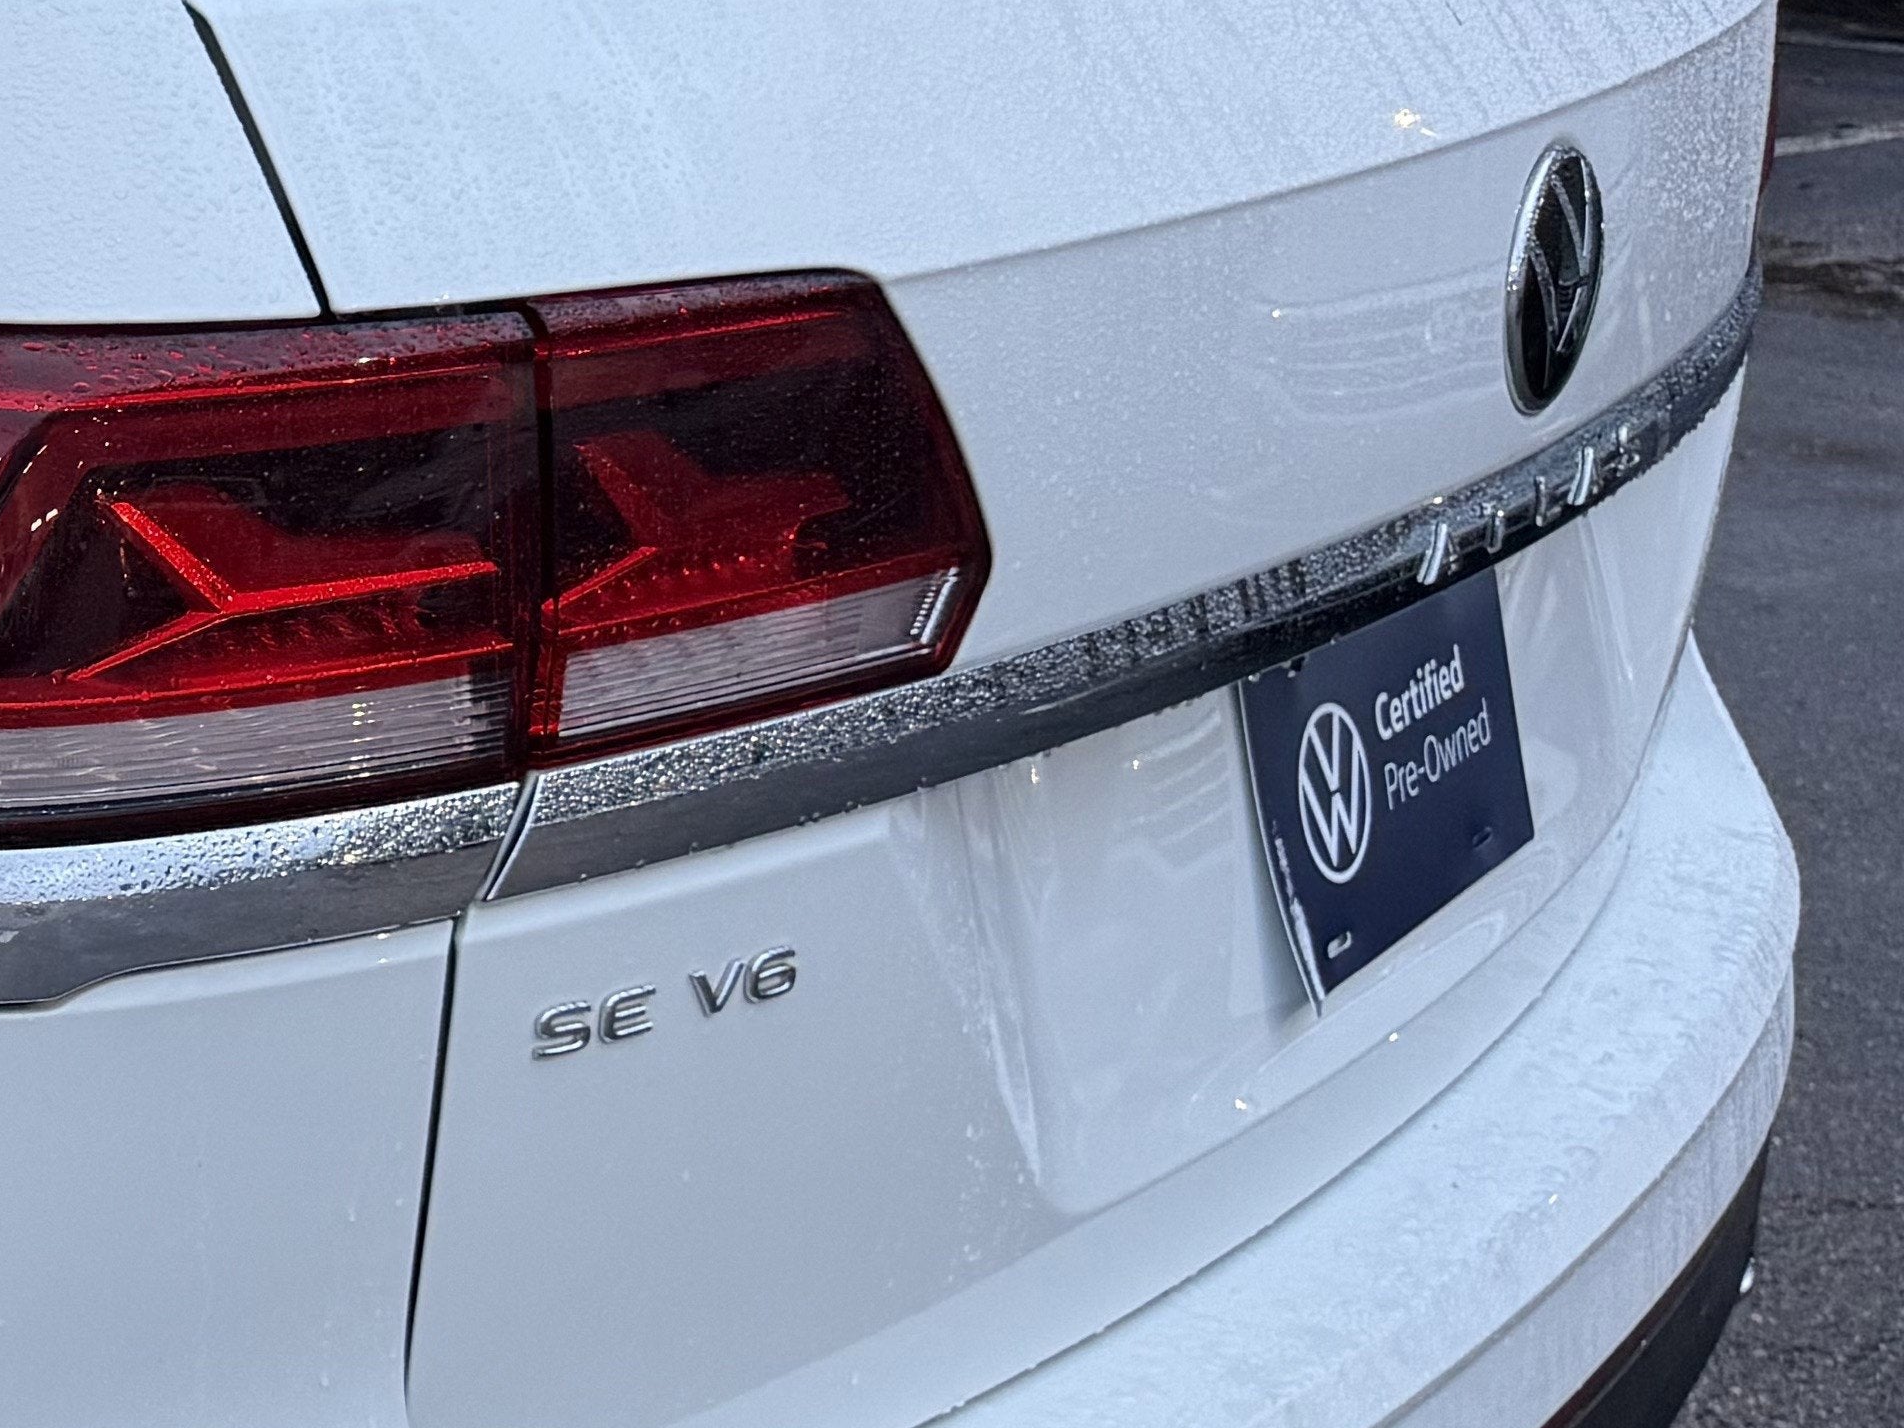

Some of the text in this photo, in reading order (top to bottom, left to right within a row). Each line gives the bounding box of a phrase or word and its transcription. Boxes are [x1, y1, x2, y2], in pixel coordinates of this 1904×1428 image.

[1375, 644, 1465, 741] Certified
[1384, 696, 1492, 810] Pre-Owned
[531, 944, 797, 1061] SE V6
